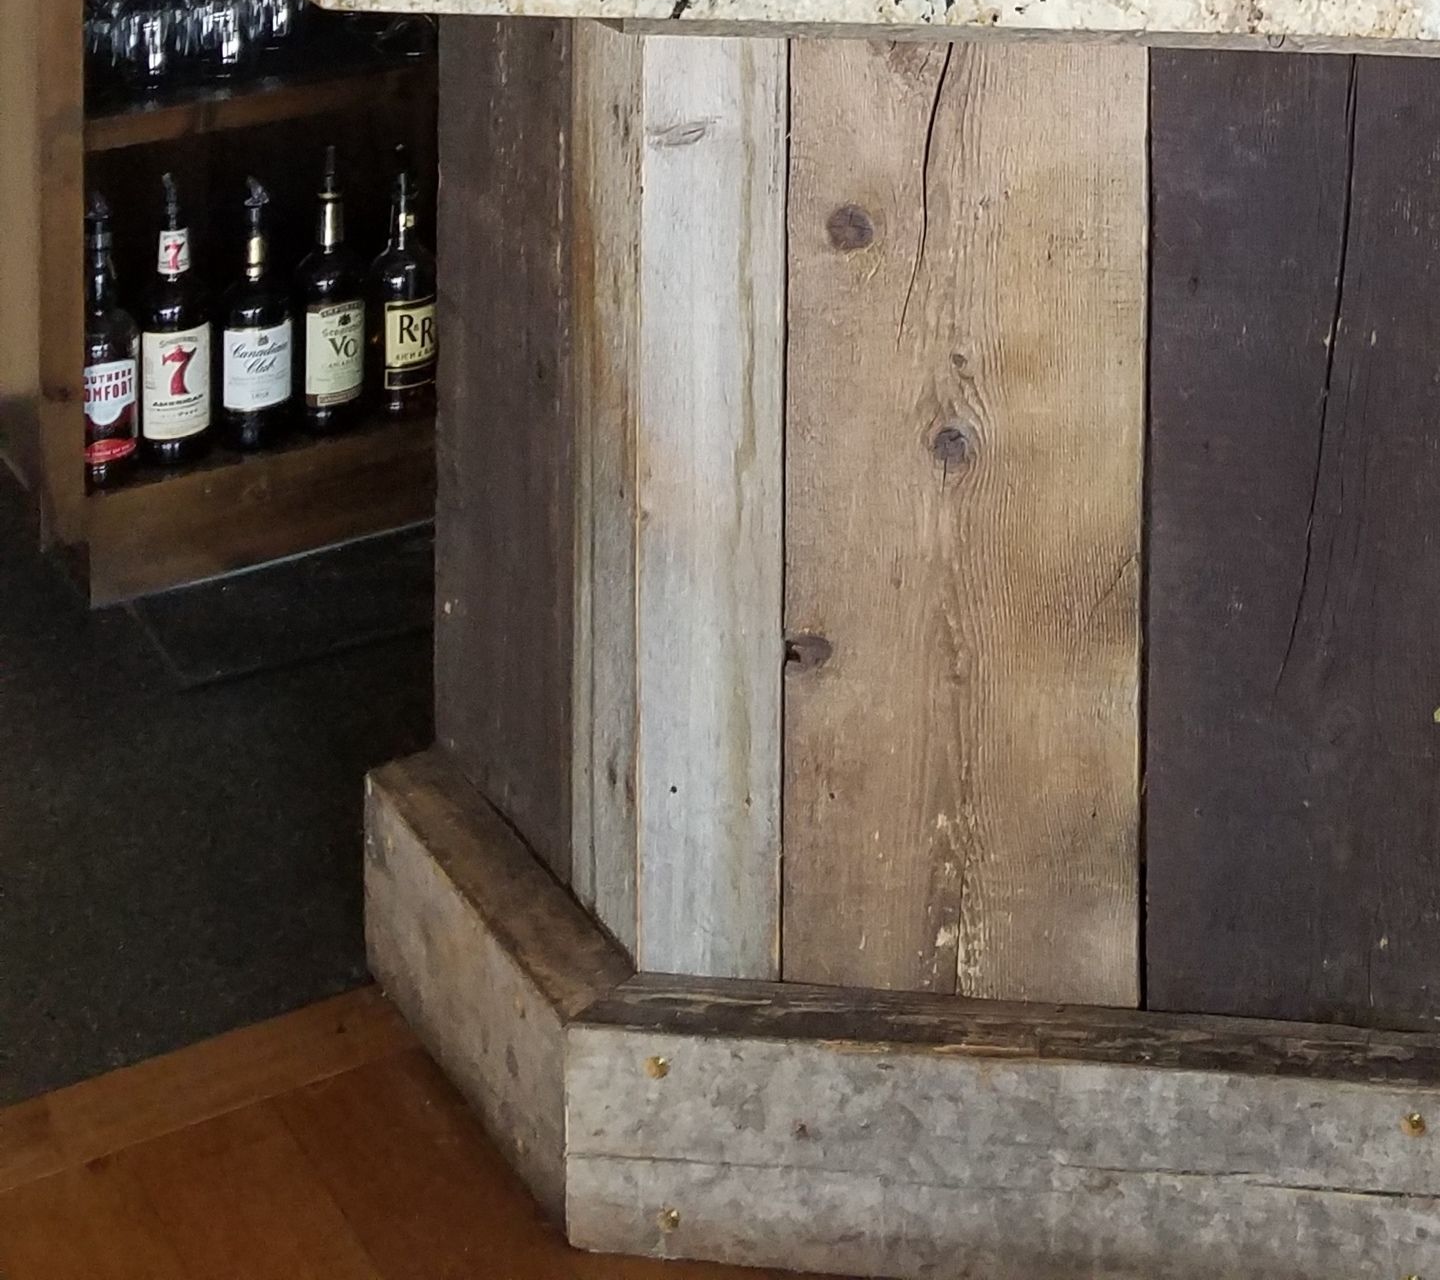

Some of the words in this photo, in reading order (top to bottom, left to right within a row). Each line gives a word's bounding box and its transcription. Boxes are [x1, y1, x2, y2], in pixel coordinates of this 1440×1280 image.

[230, 340, 289, 359] Canadian
[162, 344, 197, 396] 7
[243, 356, 277, 375] Club
